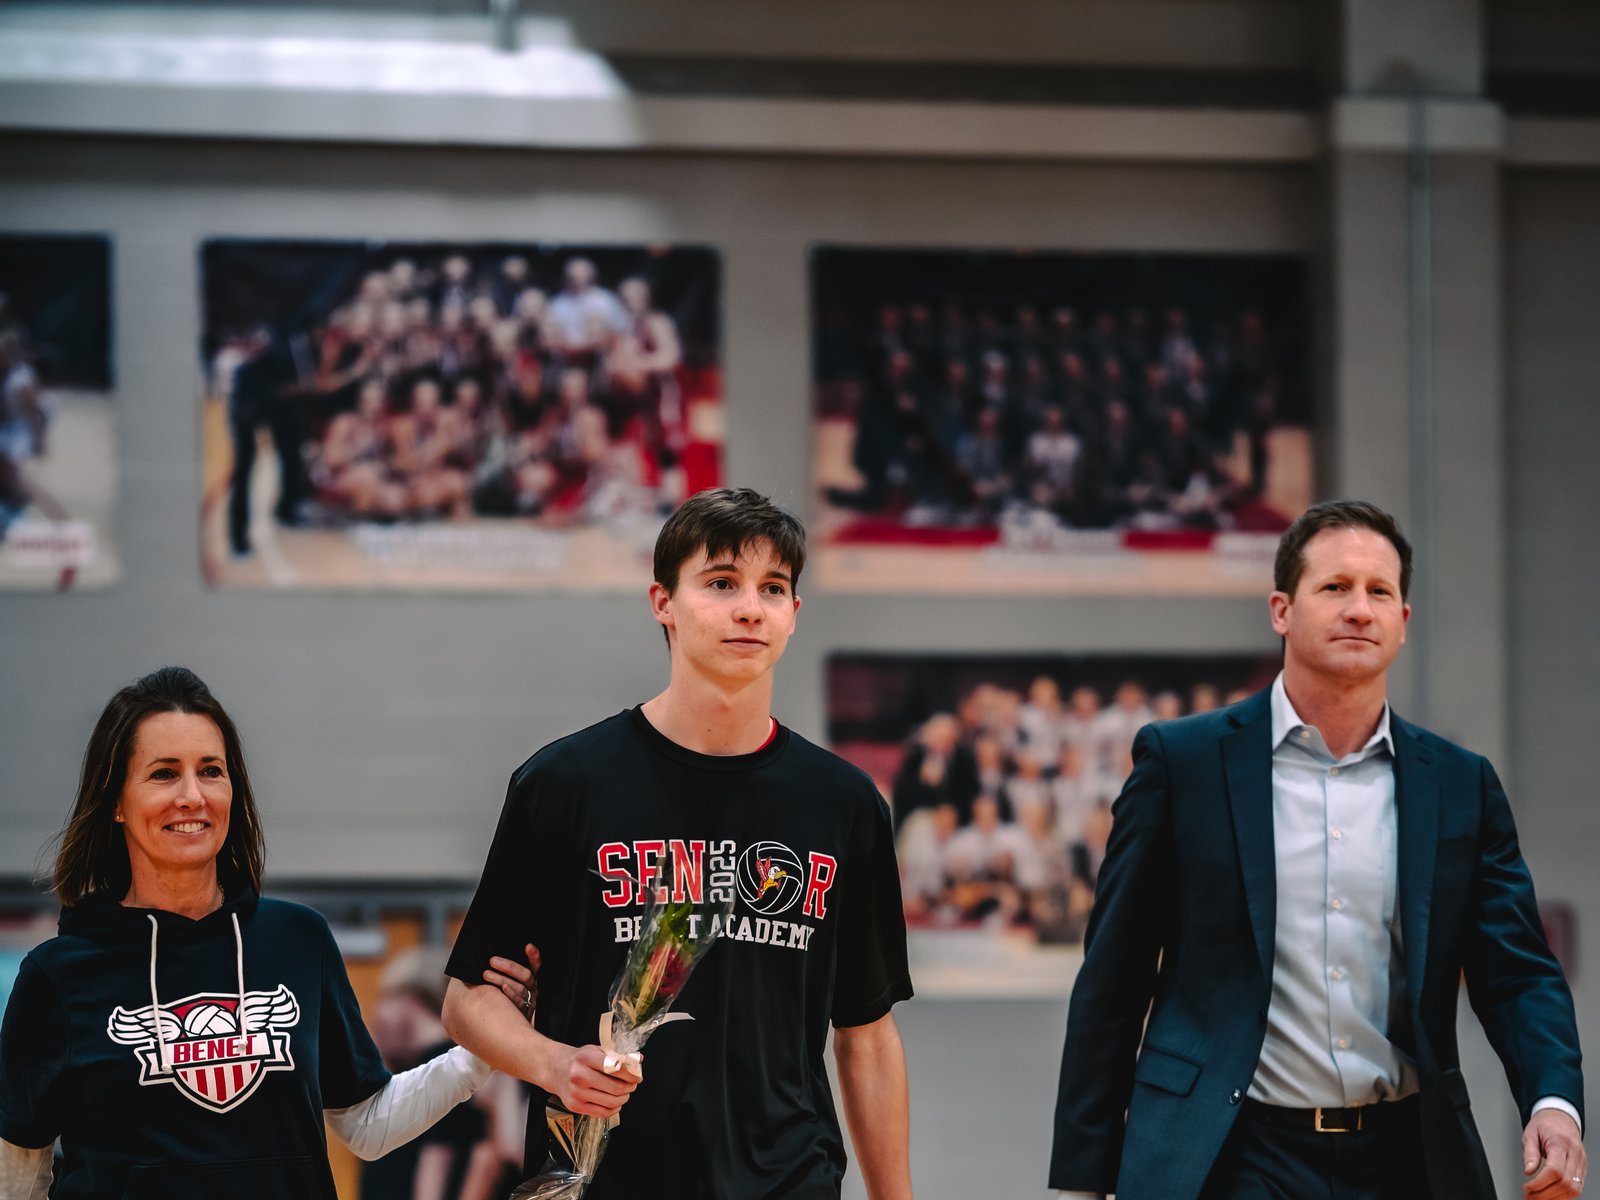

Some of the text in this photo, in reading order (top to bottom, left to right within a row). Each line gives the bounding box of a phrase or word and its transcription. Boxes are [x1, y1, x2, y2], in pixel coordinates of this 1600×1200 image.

[709, 840, 737, 904] 2025
[708, 913, 815, 952] ACADEMY
[173, 1035, 258, 1064] BENET
